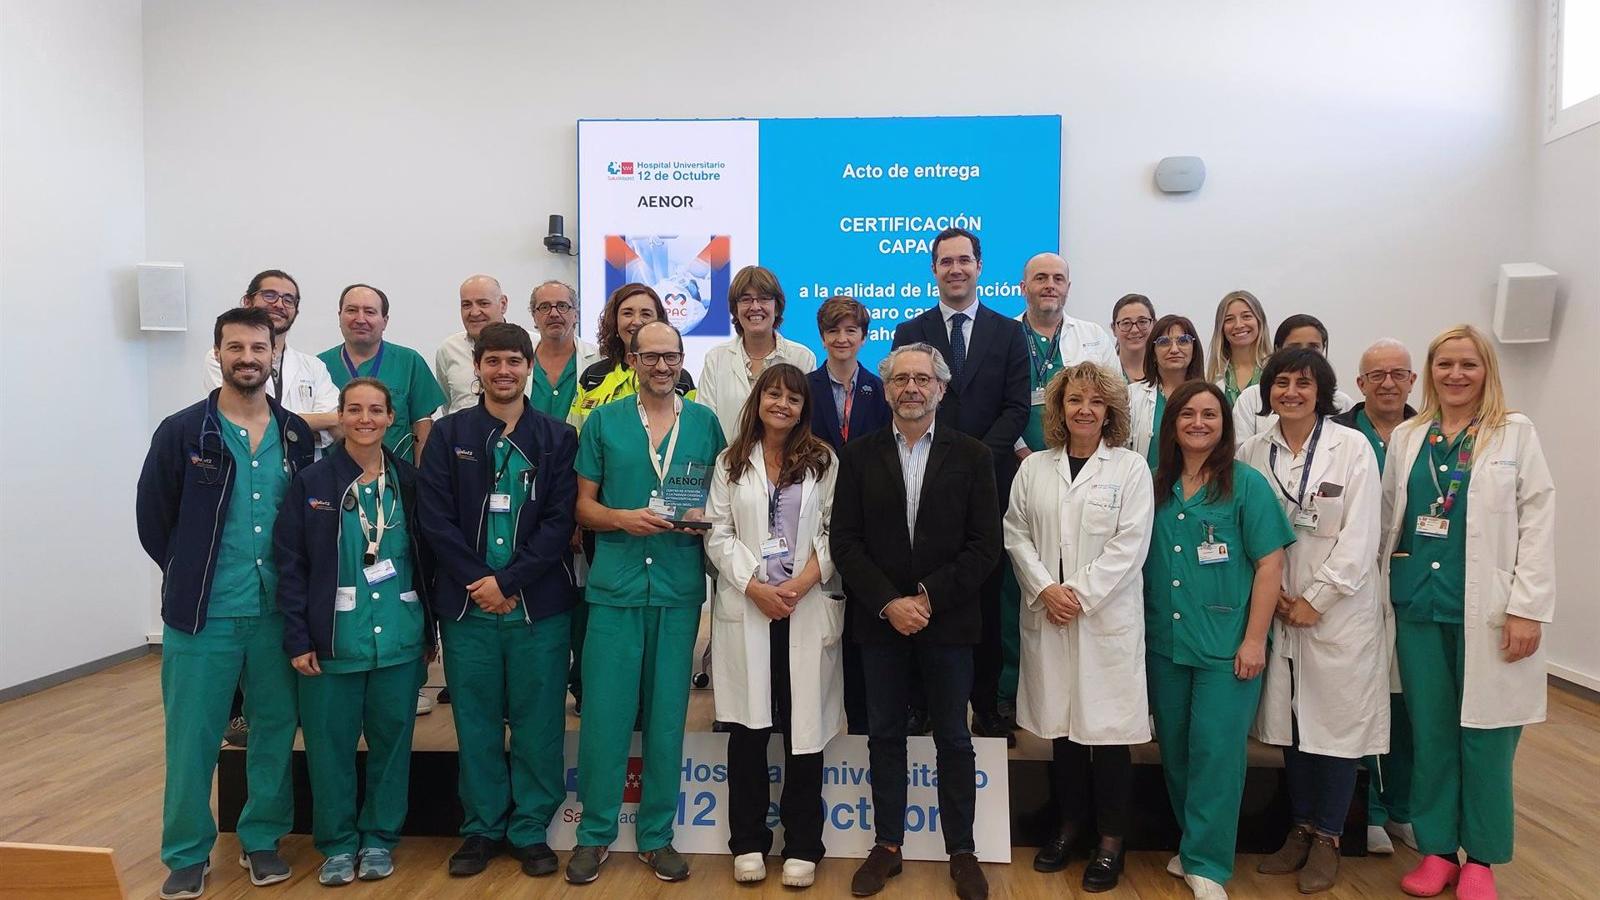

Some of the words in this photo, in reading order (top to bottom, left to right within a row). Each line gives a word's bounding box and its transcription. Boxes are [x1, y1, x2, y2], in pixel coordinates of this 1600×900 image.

[637, 161, 671, 171] Hospital
[674, 161, 725, 169] Universitario
[842, 163, 883, 178] Acto
[888, 163, 909, 178] de
[914, 163, 980, 181] entrega
[638, 171, 651, 181] 12
[655, 171, 669, 181] de
[673, 170, 721, 181] Octubre
[637, 195, 694, 208] AENOR
[840, 213, 981, 232] CERTIFICACIÓN
[800, 287, 809, 298] a
[814, 283, 828, 298] la
[834, 282, 895, 298] calidad
[900, 282, 917, 298] de
